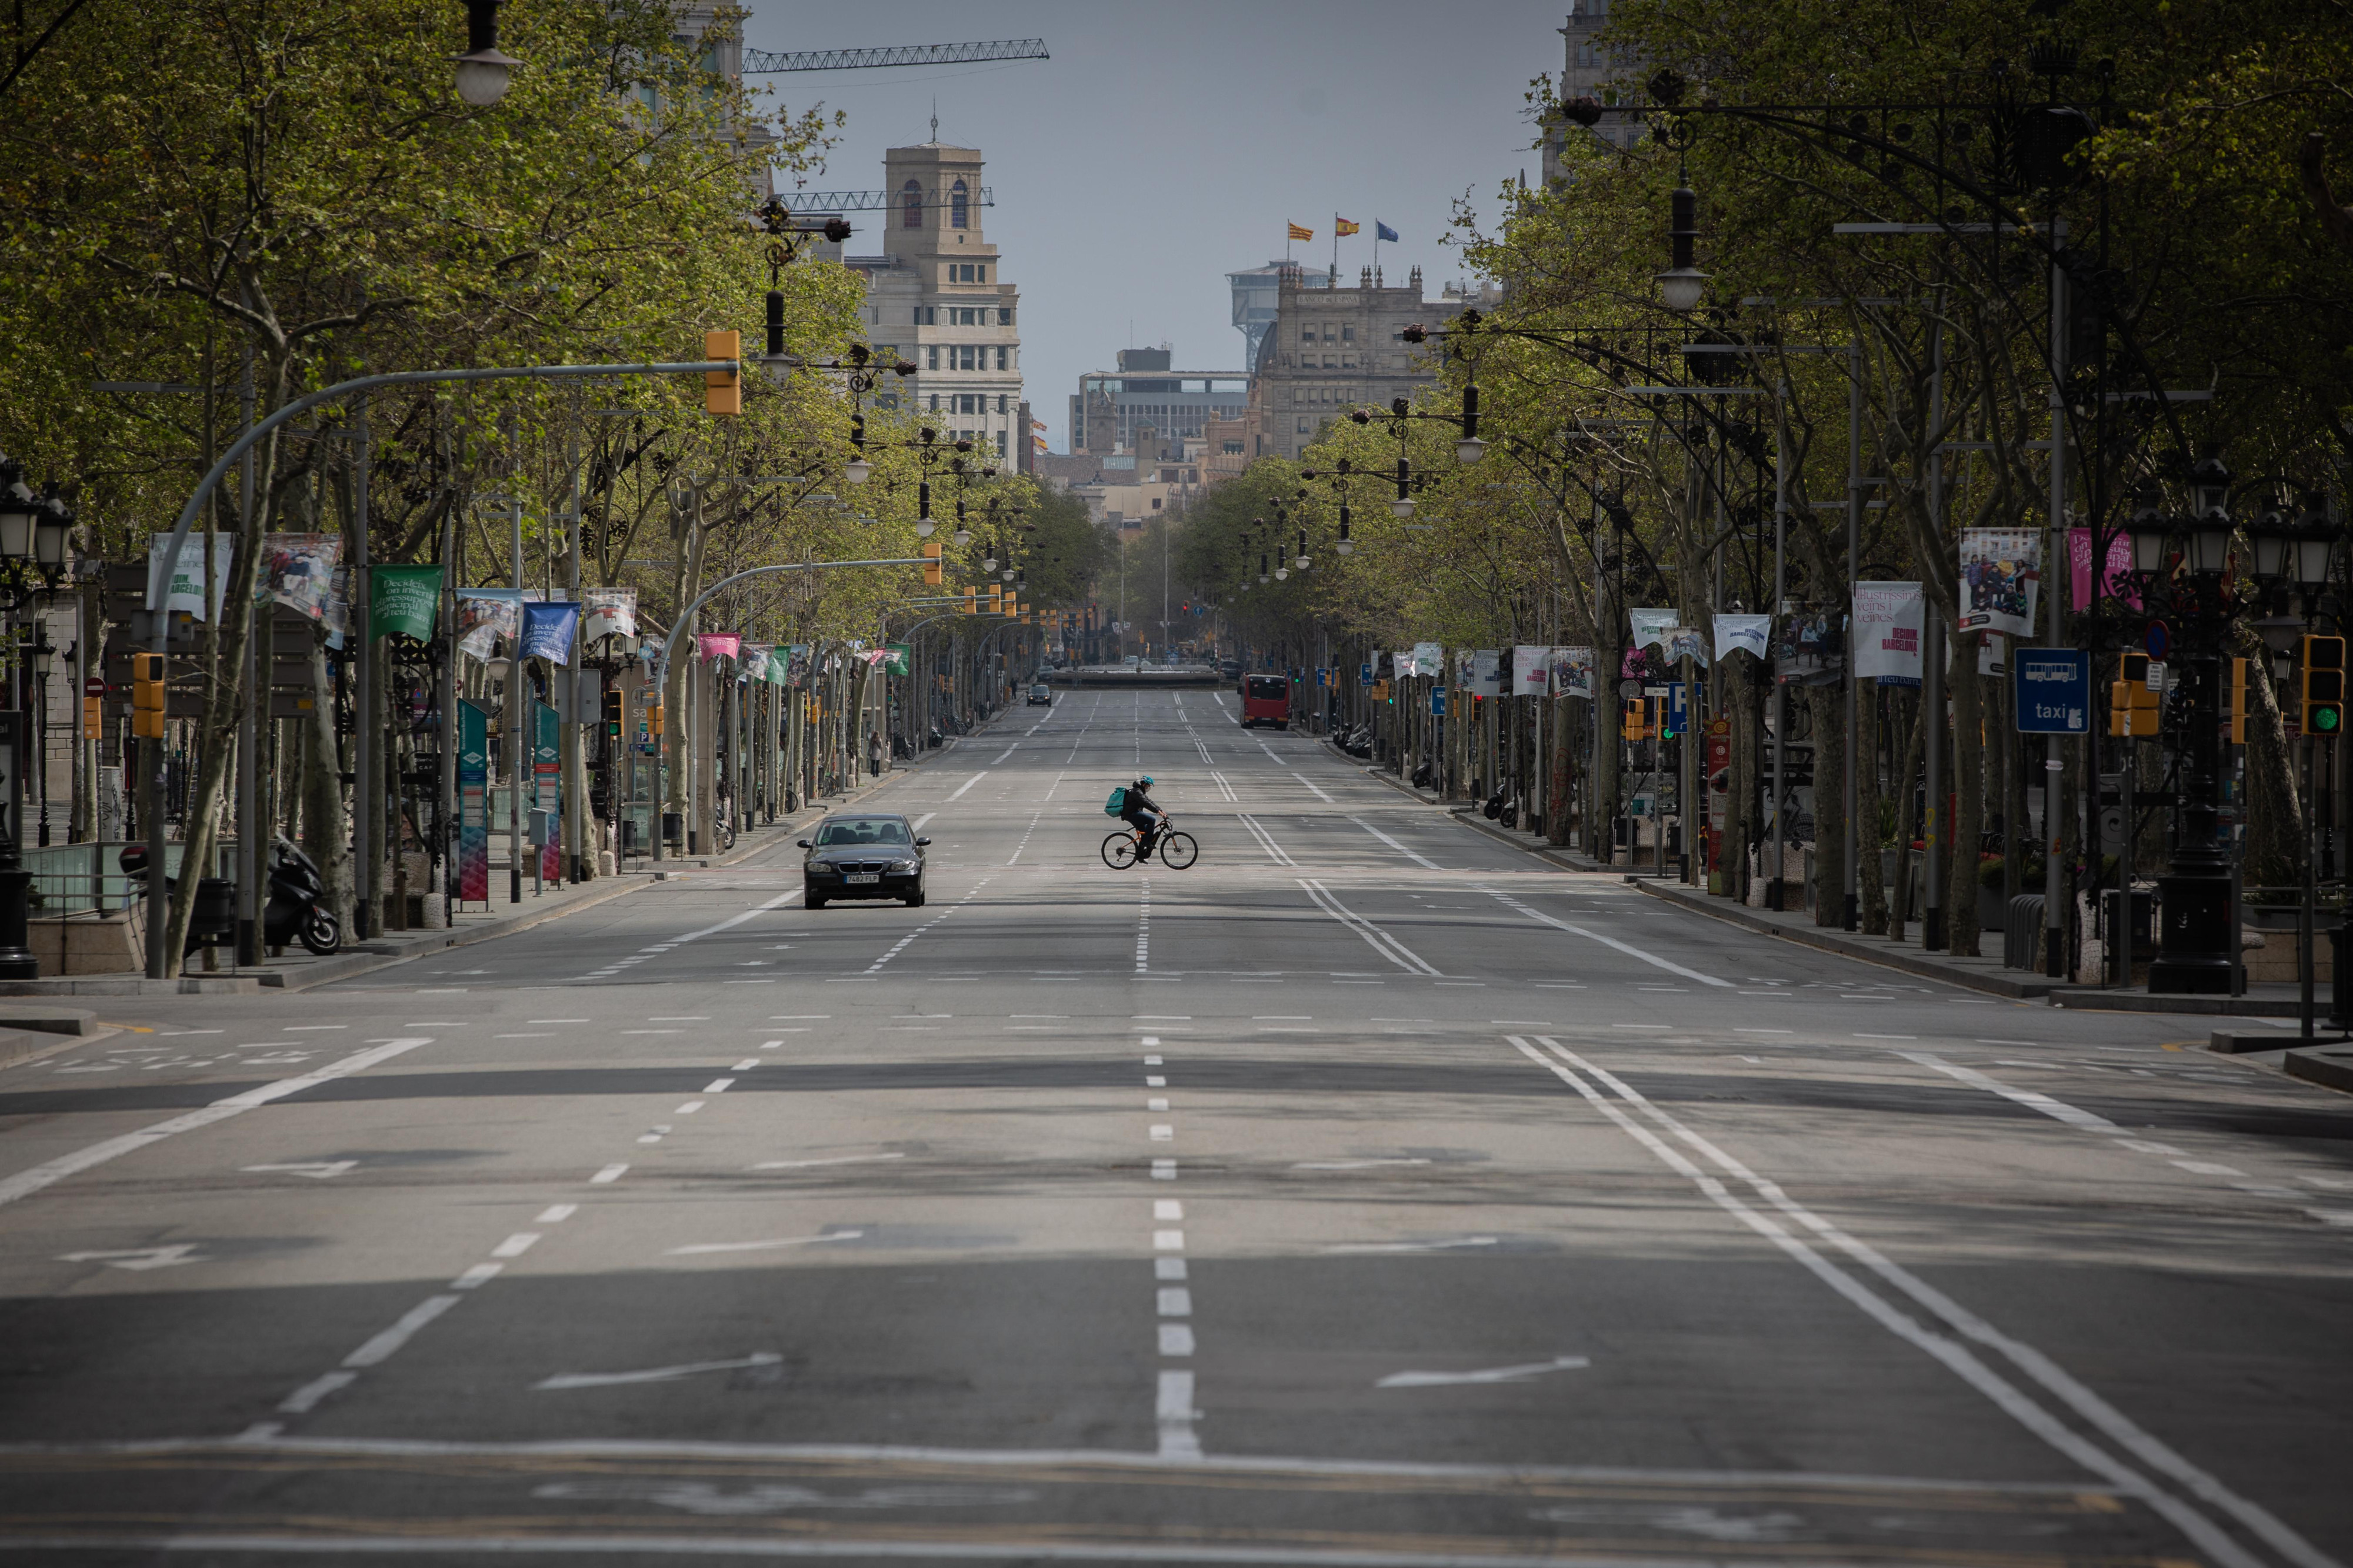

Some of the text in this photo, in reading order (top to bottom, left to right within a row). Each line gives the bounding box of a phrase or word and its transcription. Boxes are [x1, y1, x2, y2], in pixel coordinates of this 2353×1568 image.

[169, 584, 205, 597] ARCELON
[383, 579, 427, 590] Decideix
[402, 586, 436, 600] invertir
[375, 600, 419, 616] municipal
[382, 594, 435, 609] pressupost
[1857, 600, 1892, 612] veïns i
[381, 608, 390, 619] al
[408, 608, 431, 625] barri.
[1857, 611, 1895, 623] veïnes.
[1729, 632, 1759, 642] BARCELONA
[1745, 628, 1765, 642] DECIDIM.
[1892, 627, 1919, 640] DECIDIM.
[1882, 638, 1918, 652] BARCELONA
[2035, 702, 2066, 719] taxi
